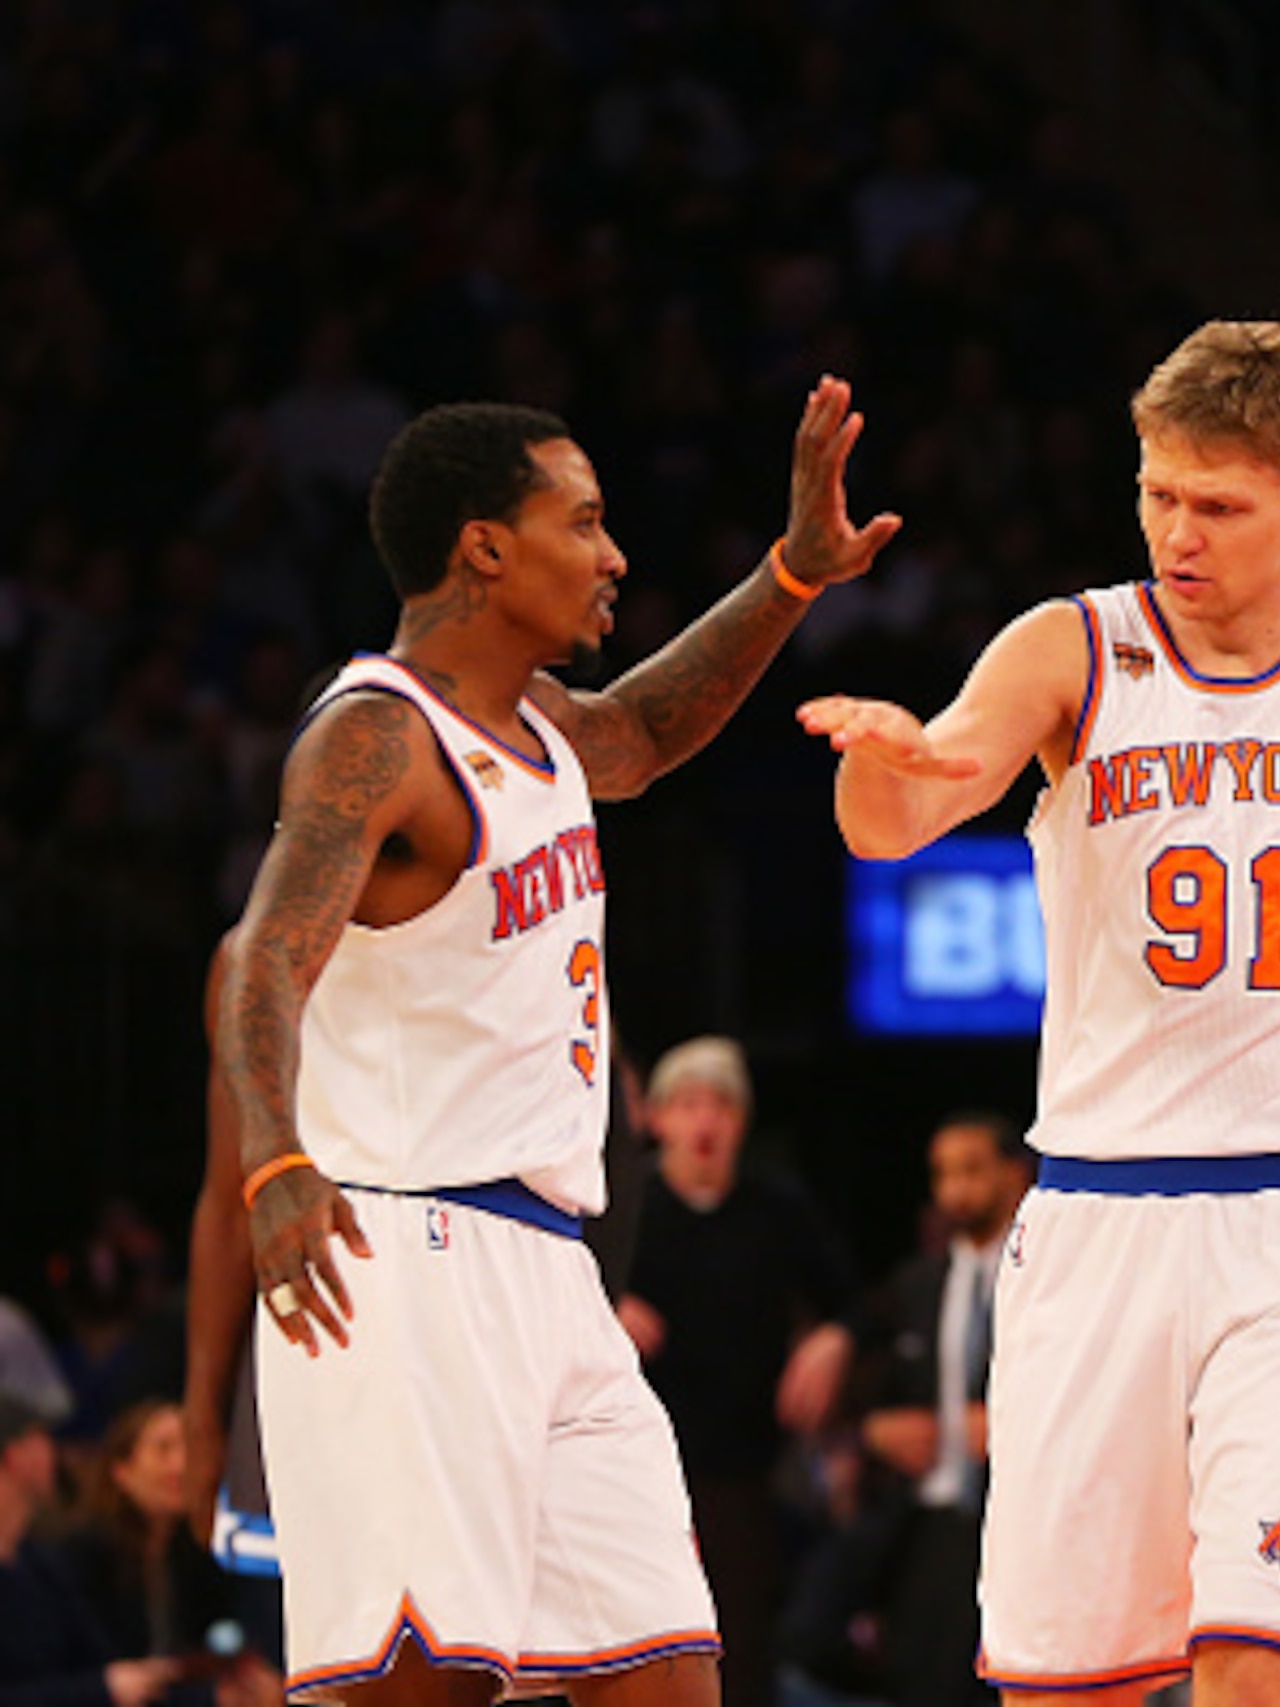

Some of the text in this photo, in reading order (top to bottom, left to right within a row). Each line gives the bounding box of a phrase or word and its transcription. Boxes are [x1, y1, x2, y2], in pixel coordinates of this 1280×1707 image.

[1086, 742, 1217, 828] NEW
[489, 842, 565, 942] NEW
[566, 938, 601, 1089] 3
